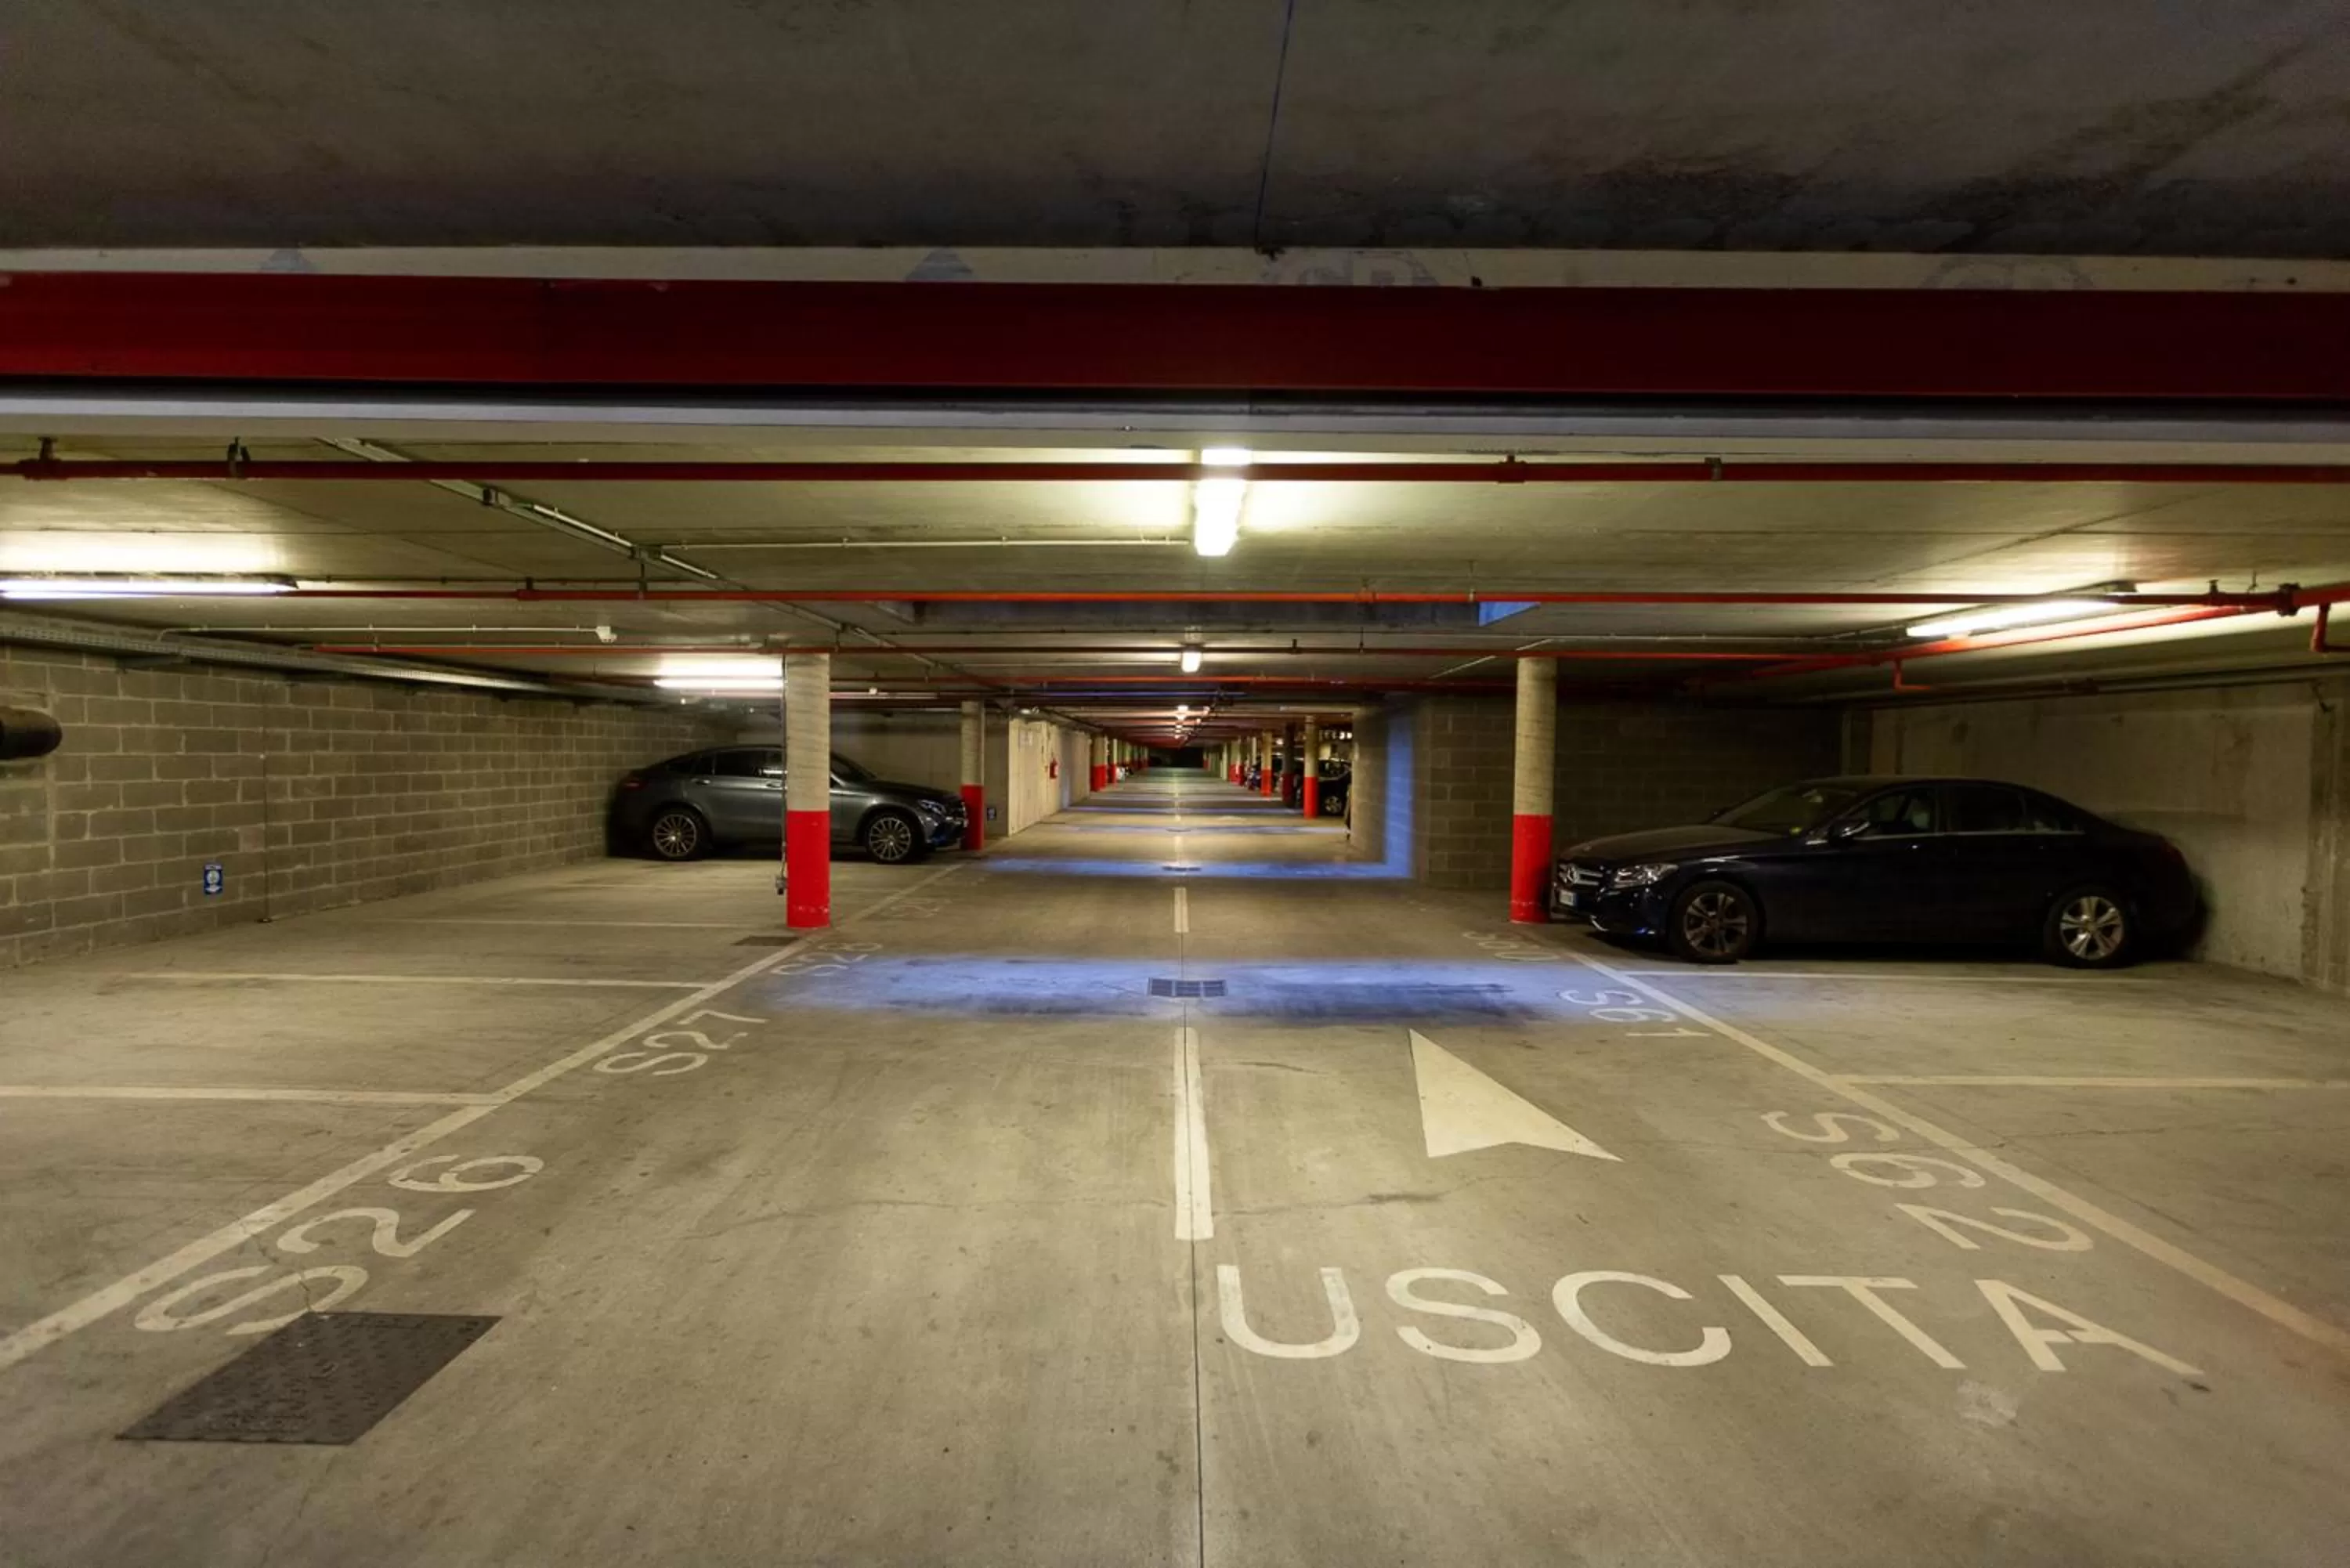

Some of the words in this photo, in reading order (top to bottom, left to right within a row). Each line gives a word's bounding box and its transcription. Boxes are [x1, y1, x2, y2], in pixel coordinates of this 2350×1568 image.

[591, 1008, 768, 1076] S27
[1556, 989, 1712, 1037] S61
[1759, 1109, 2095, 1252] S62
[134, 1154, 544, 1335] S26
[1217, 1263, 2205, 1375] USCITA
